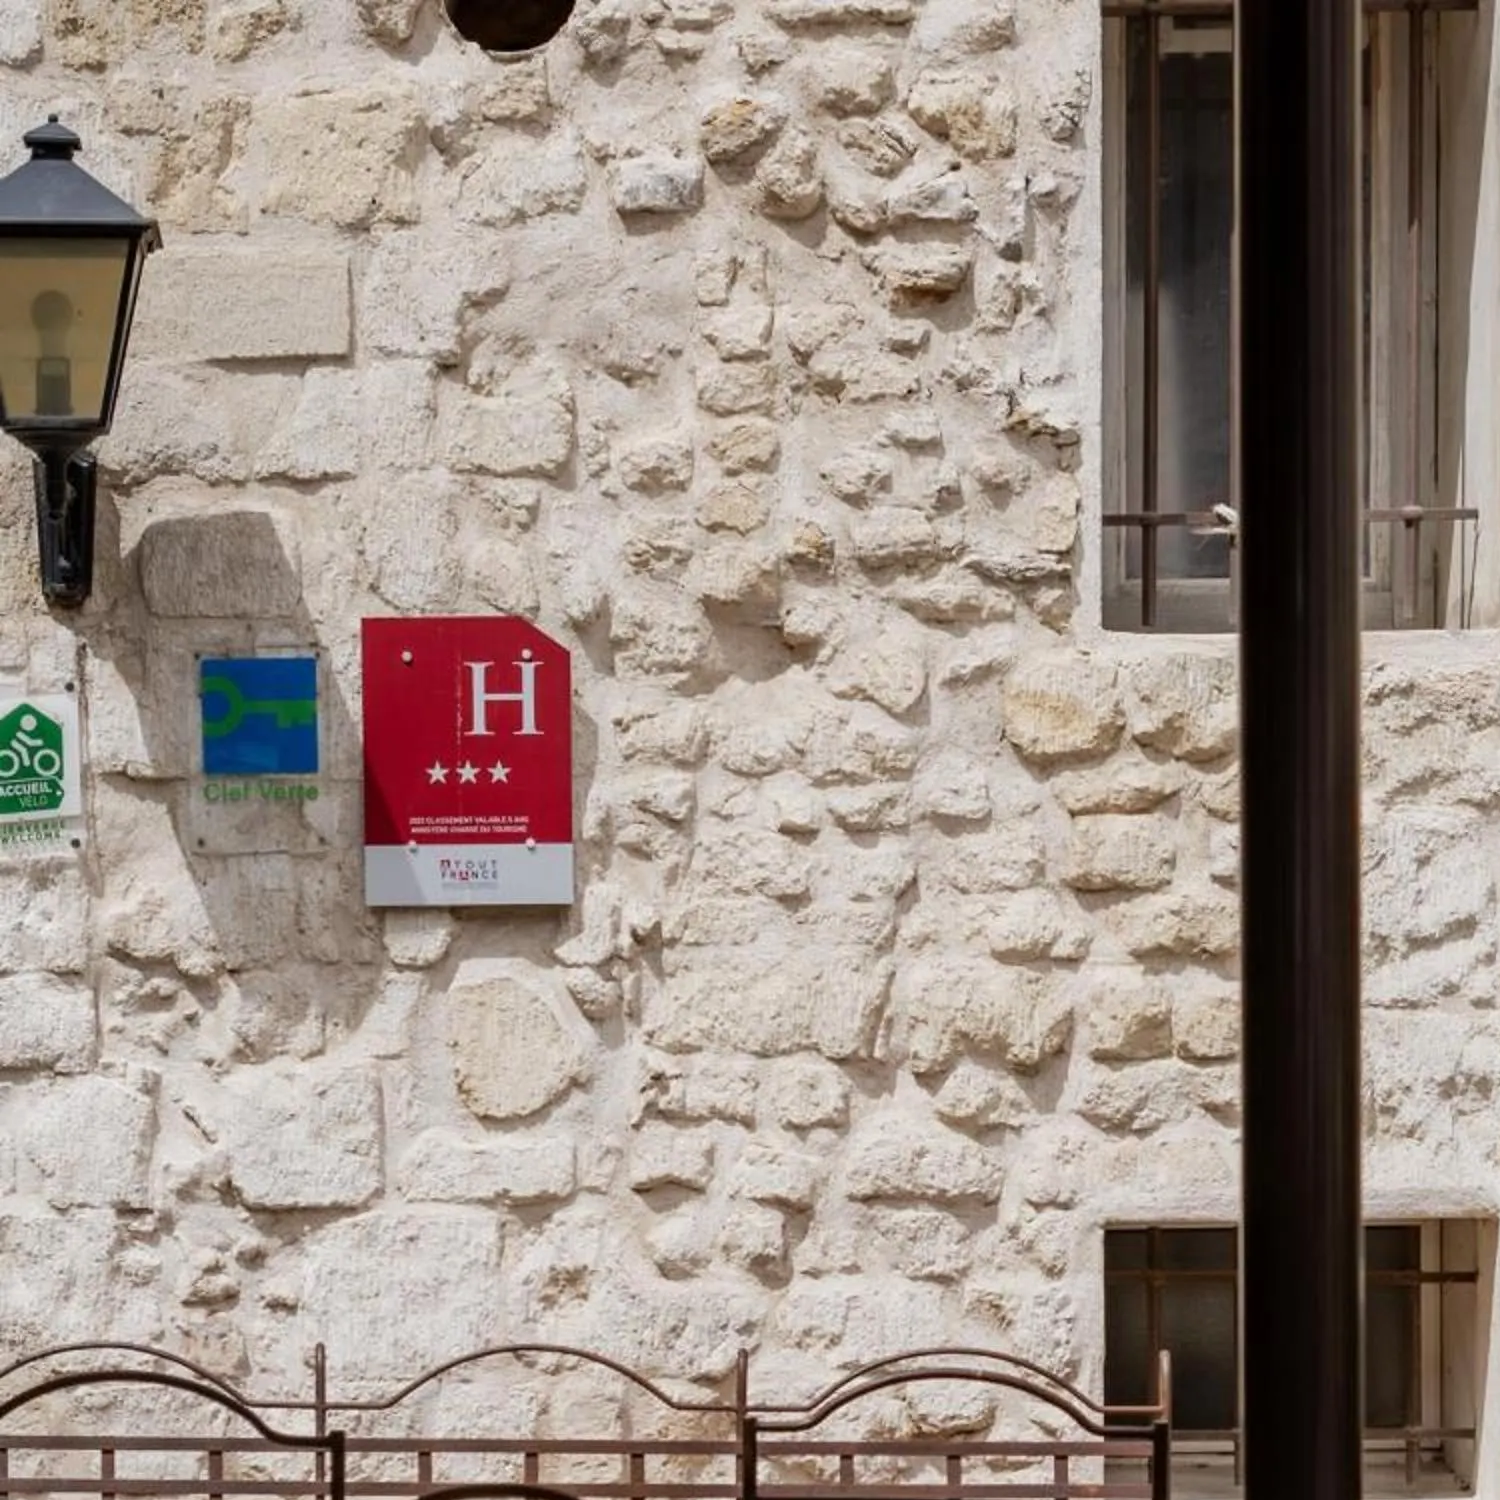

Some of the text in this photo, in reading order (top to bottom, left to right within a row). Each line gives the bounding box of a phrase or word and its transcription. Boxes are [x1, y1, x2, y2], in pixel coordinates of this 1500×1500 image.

[463, 661, 545, 736] H
[203, 782, 319, 803] Clef Verte
[441, 870, 498, 881] FRANCE
